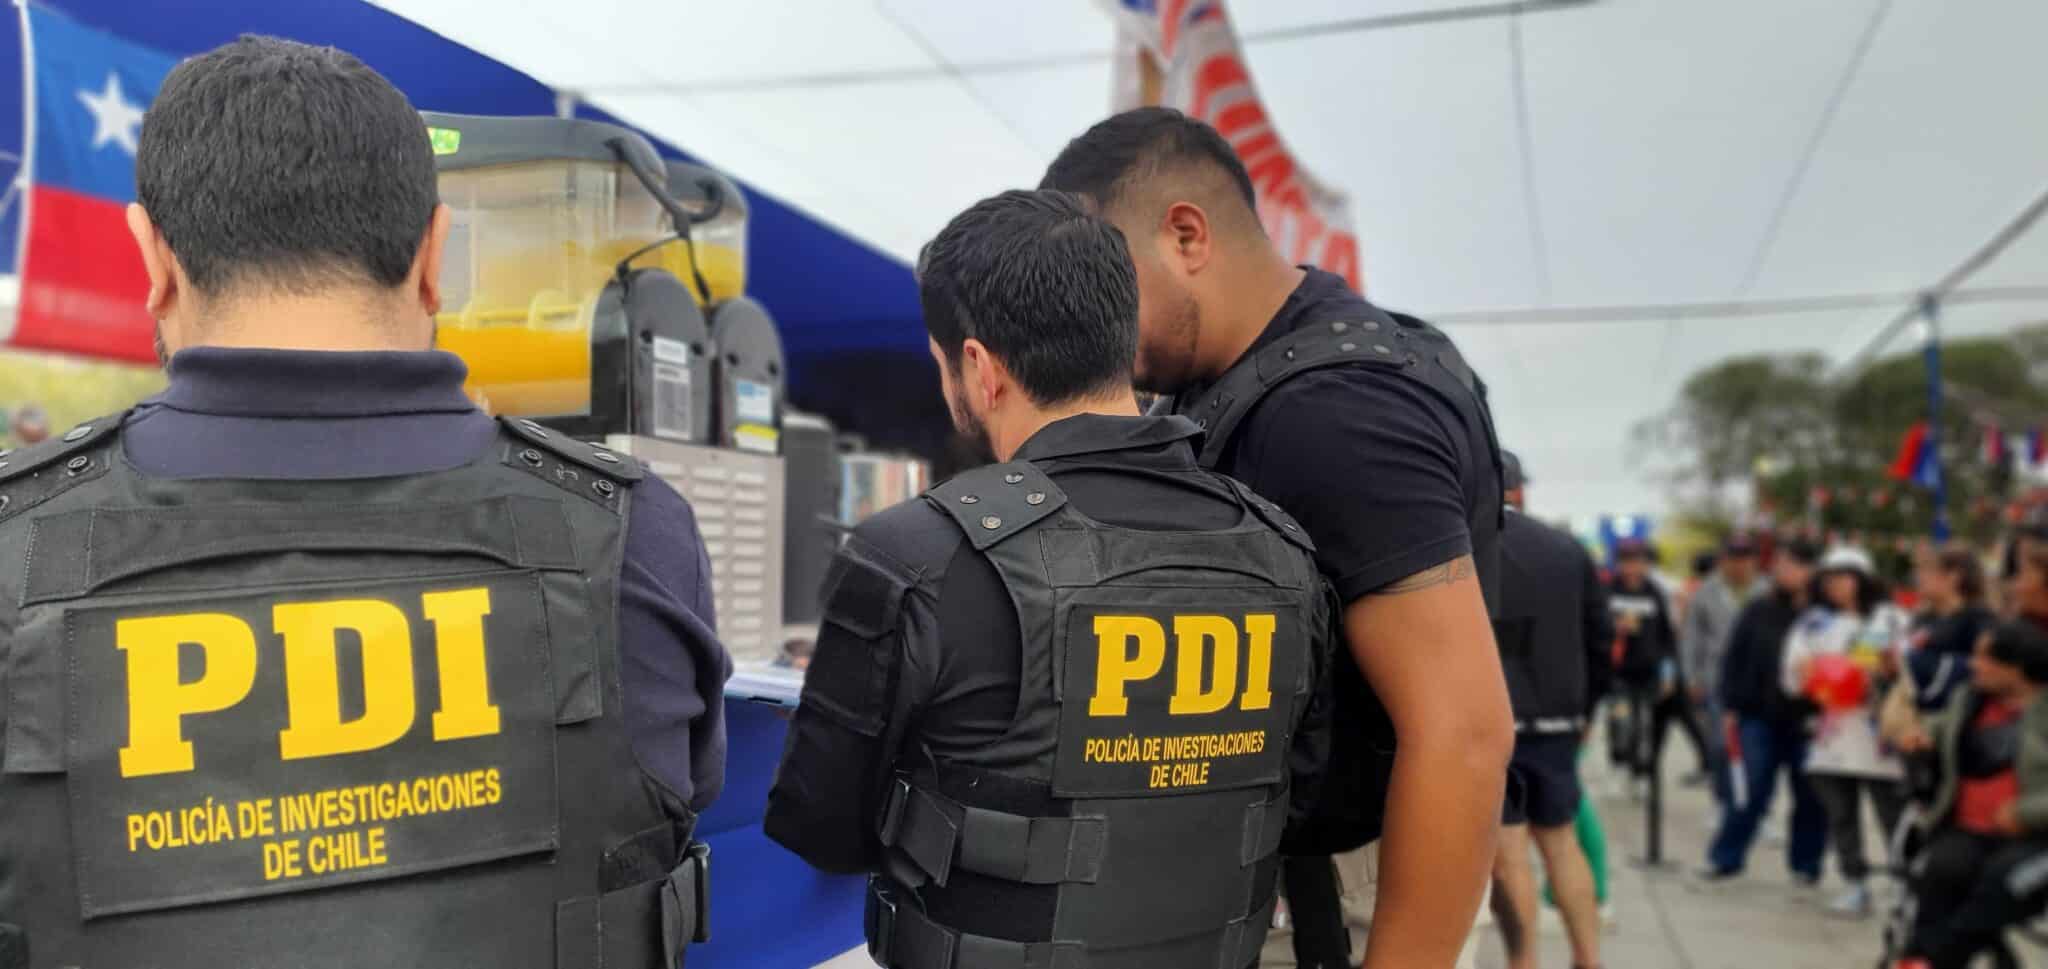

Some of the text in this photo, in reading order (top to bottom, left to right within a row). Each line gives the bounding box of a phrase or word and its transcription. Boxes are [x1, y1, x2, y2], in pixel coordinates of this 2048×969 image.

[114, 586, 502, 778] PDI
[1088, 613, 1276, 717] PDI
[1084, 730, 1265, 763] POLICÍA DE INVESTIGACIONES
[1150, 762, 1210, 788] DE CHILE
[126, 768, 502, 852] POLICÍA DE INVESTIGACIONES
[262, 828, 387, 880] DE CHILE
